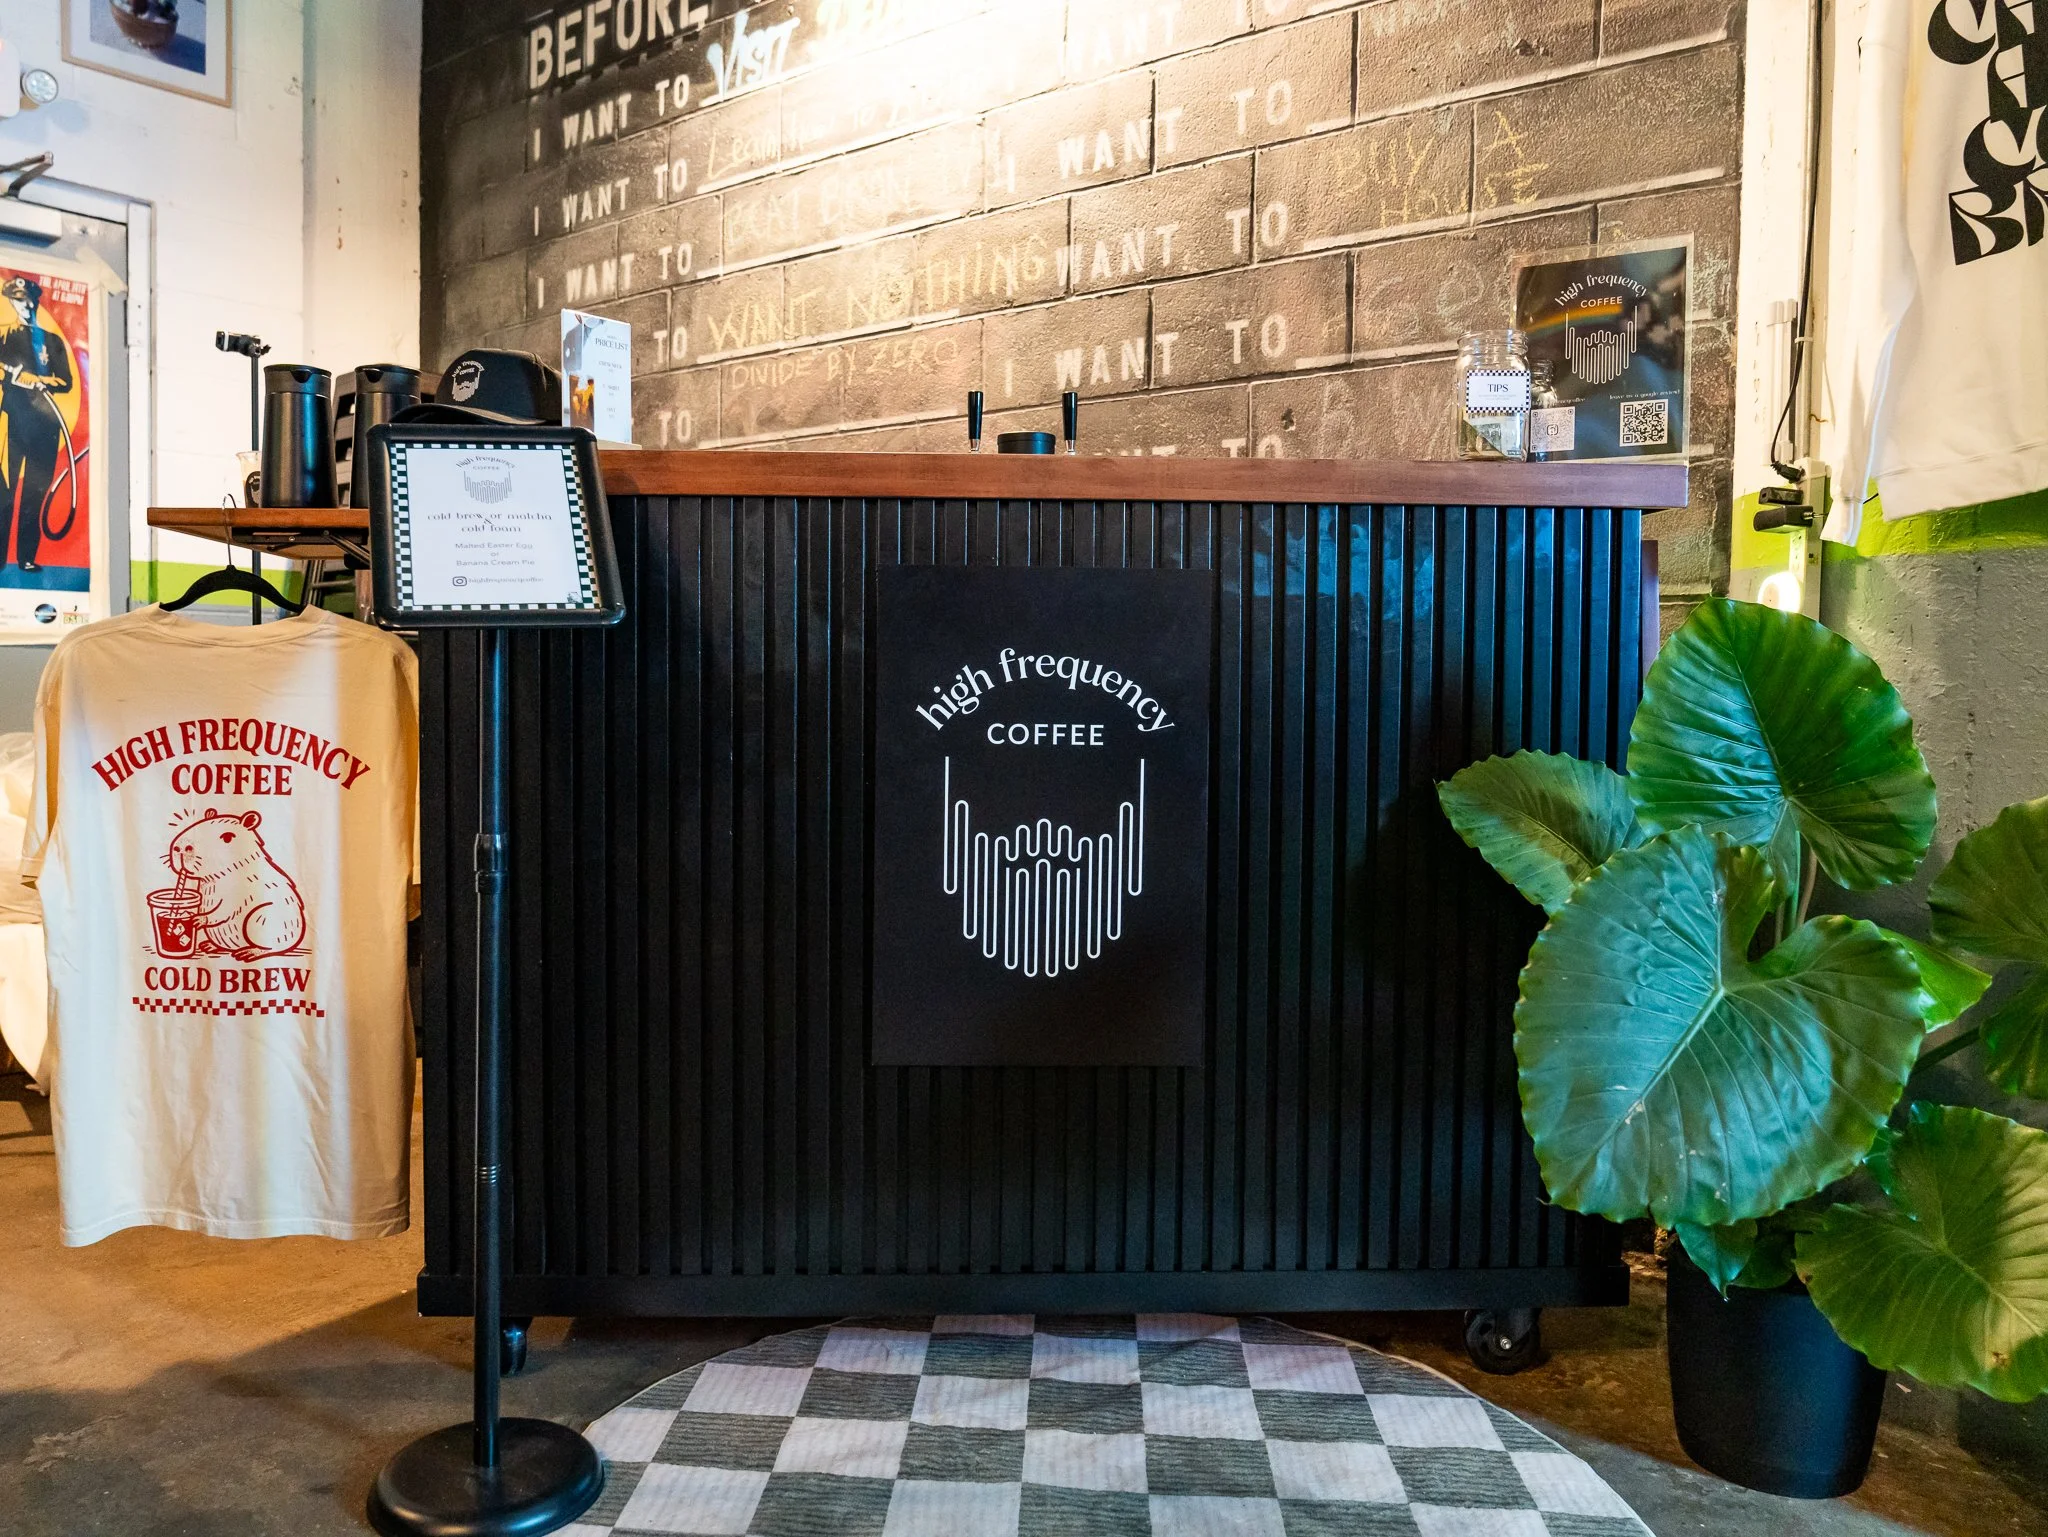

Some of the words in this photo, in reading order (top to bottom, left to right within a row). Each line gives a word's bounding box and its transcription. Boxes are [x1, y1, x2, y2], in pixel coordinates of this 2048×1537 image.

[533, 128, 541, 162] I
[562, 93, 632, 150] WANT
[655, 74, 690, 117] TO
[1057, 106, 1183, 180] WANT
[1231, 79, 1293, 135] TO
[1484, 110, 1528, 160] A
[533, 206, 540, 236] I
[562, 177, 630, 232] WANT
[654, 158, 688, 200] TO
[1055, 223, 1179, 287] WANT
[1225, 202, 1288, 255] TO
[537, 278, 544, 309] I
[566, 253, 634, 303] WANT
[658, 242, 692, 281] TO
[1554, 282, 1584, 306] high
[1586, 274, 1647, 298] frequency
[707, 291, 817, 350] WANT
[1580, 295, 1623, 308] COFFEE
[595, 337, 614, 350] PRICE
[614, 340, 628, 352] LIST
[653, 326, 688, 364] TO
[731, 349, 815, 390] DIVIDE
[827, 344, 856, 386] BY
[867, 336, 958, 375] ZERO
[1005, 358, 1013, 398] I
[1055, 331, 1179, 390] WANT
[1225, 314, 1287, 365] TO
[1487, 383, 1509, 393] TIPS
[658, 409, 692, 450] TO
[455, 456, 474, 468] high
[427, 512, 451, 521] cold
[456, 512, 484, 520] brew
[490, 512, 502, 520] or
[461, 524, 485, 533] cold
[490, 524, 521, 533] foam
[915, 664, 995, 731] high
[998, 647, 1175, 733] frequency
[91, 726, 175, 792] HIGH
[178, 718, 371, 791] FREQUENCY
[987, 723, 1104, 746] COFFEE
[171, 763, 293, 796] COFFEE
[144, 966, 212, 992] COLD
[219, 966, 312, 994] BREW
